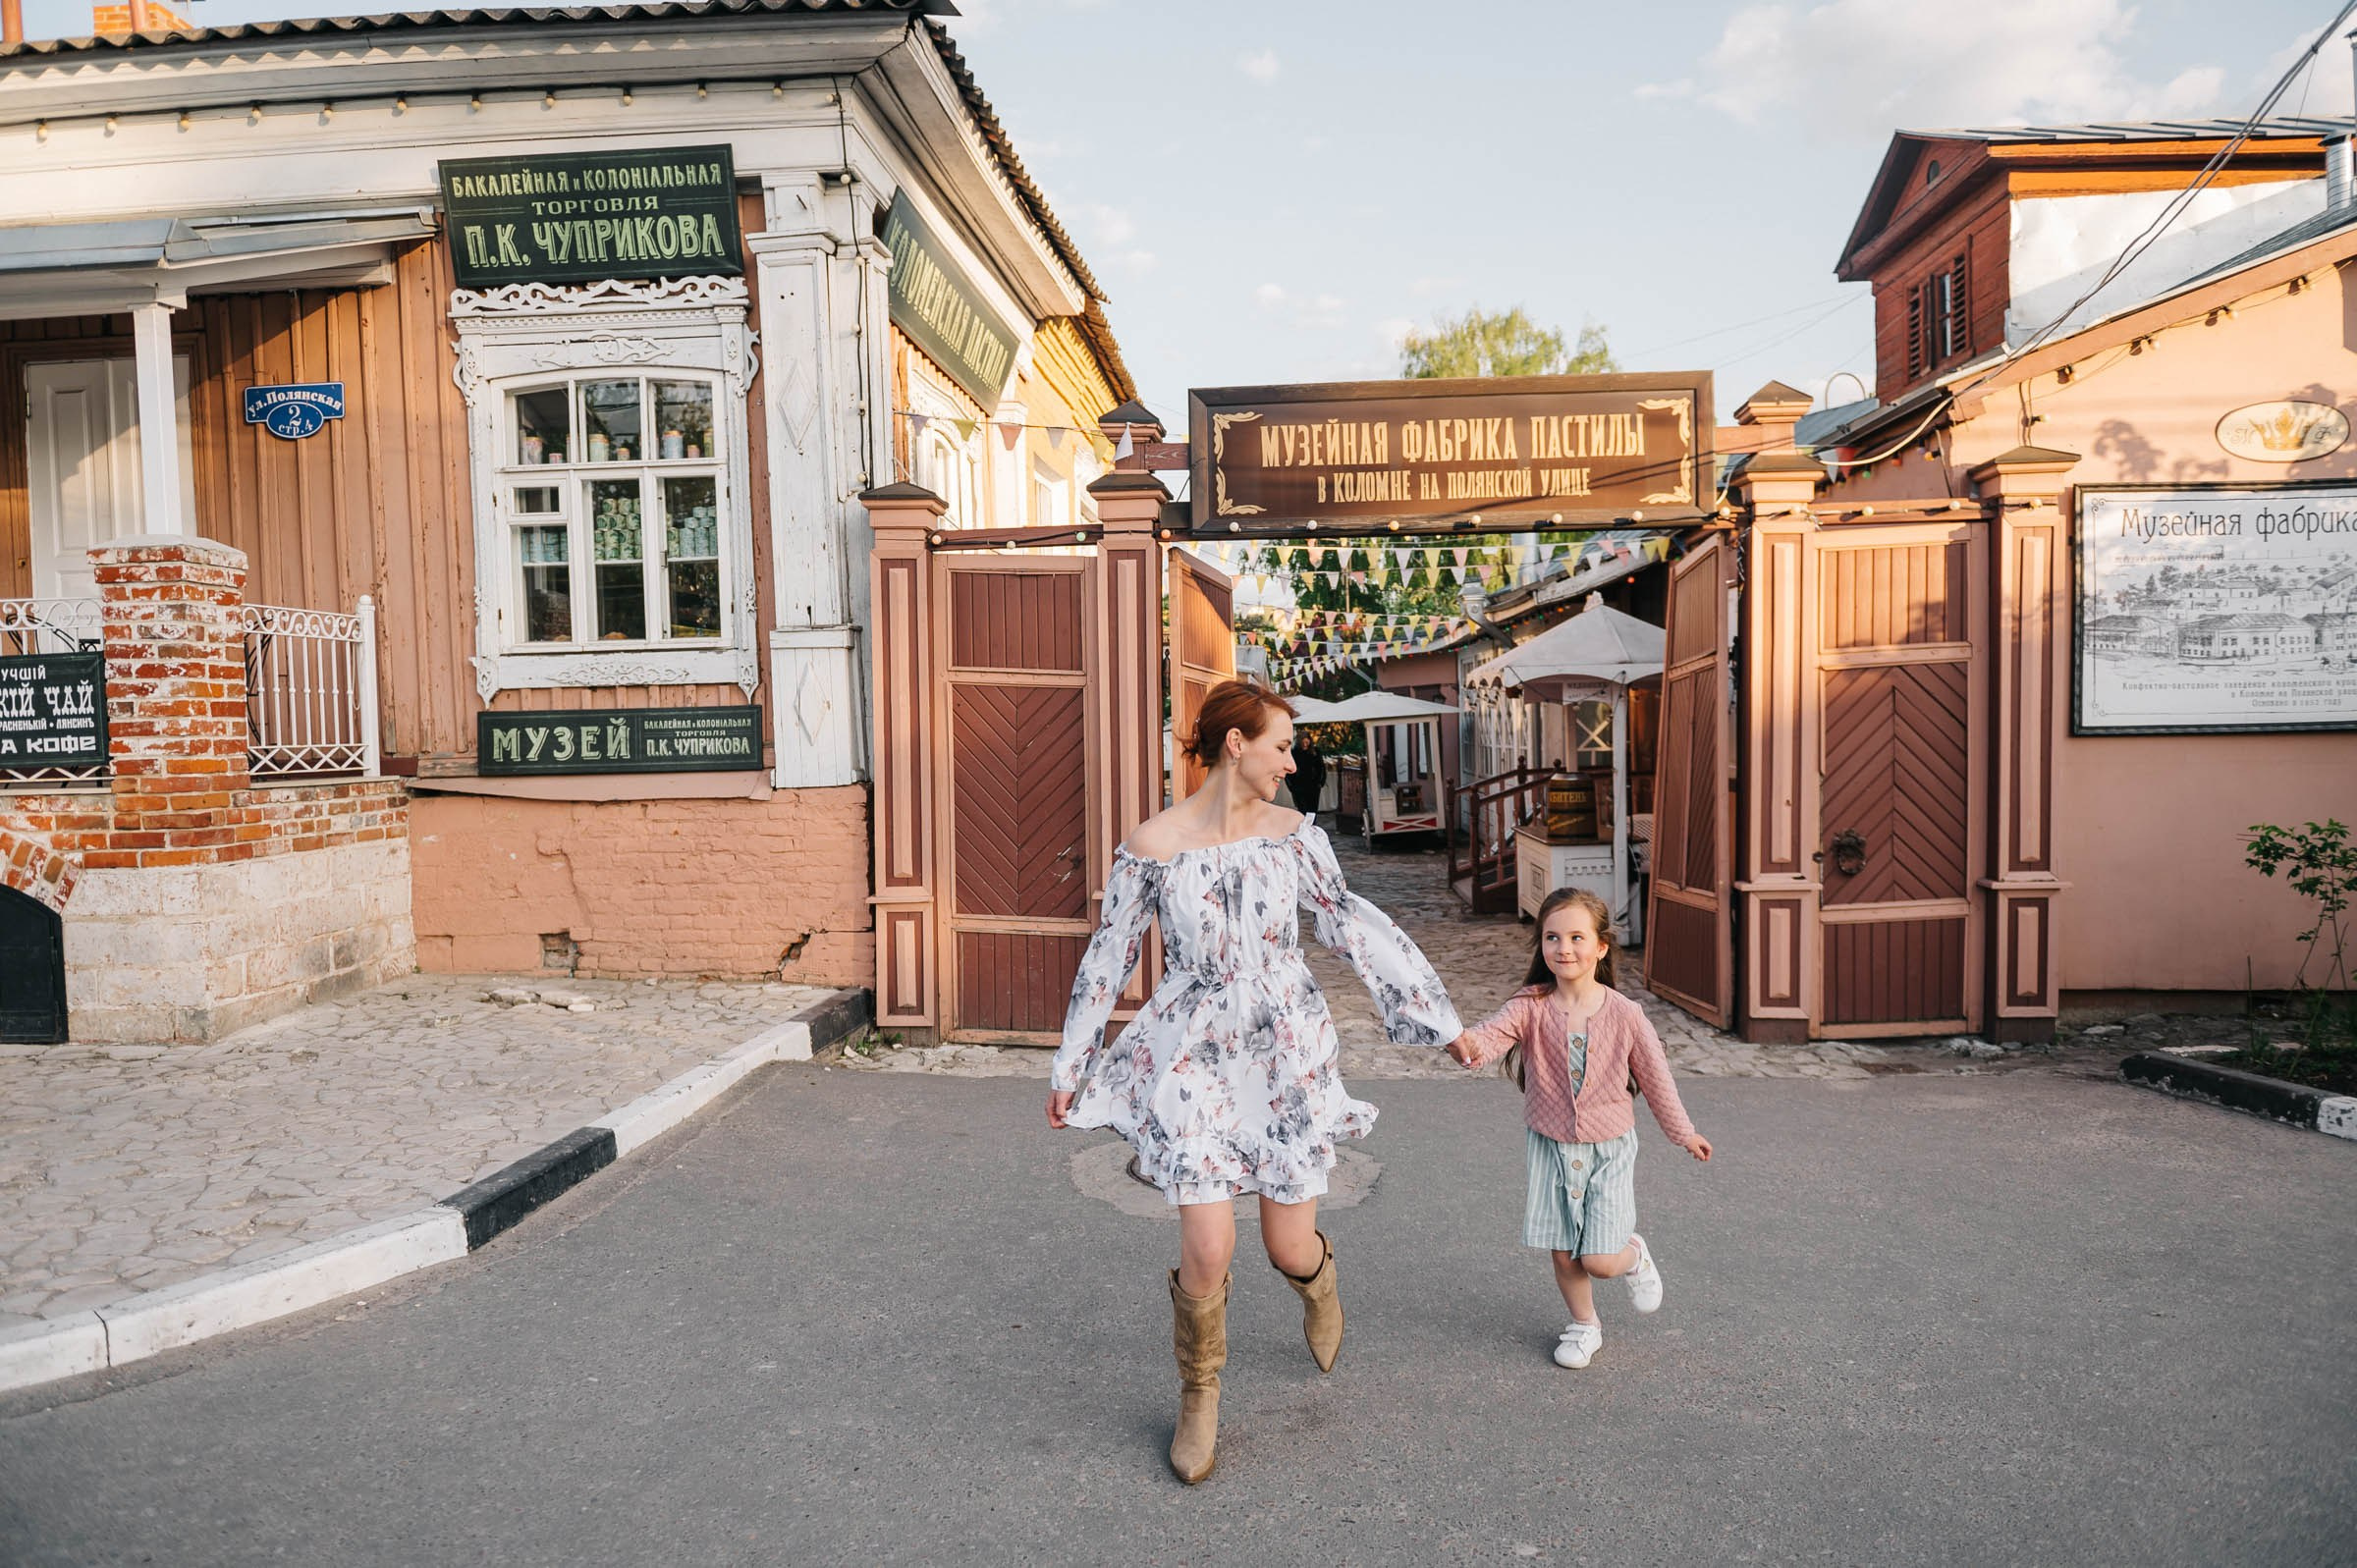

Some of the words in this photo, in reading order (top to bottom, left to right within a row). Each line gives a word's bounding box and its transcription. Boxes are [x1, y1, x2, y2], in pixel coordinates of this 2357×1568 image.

[452, 169, 569, 197] БАКАЛЕЙНАЯ
[583, 162, 722, 191] КОЛОНІАЛЬНАЯ
[531, 195, 659, 216] ТОРГОВЛЯ
[532, 213, 726, 265] ЧУПРИКОВА
[288, 405, 301, 427] 2
[1260, 418, 1389, 467] МУЗЕЙНАЯ
[1401, 417, 1518, 463] ФАБРИКА
[1530, 412, 1645, 460] ПАСТИЛЫ
[1334, 470, 1411, 503] КОЛОМНЕ
[1420, 472, 1441, 500] НА
[1447, 466, 1533, 500] ПОЛЯНСКОЙ
[1540, 467, 1592, 498] УЛИЦЕ
[2121, 508, 2241, 544] Музейная
[43, 679, 94, 717] ЧАЙ
[492, 717, 631, 762] МУЗЕЙ
[644, 719, 691, 730] БАКАЛЕЙНАЯ
[26, 734, 96, 754] КОФЕ
[674, 736, 751, 756] ЧУПРИКОВА
